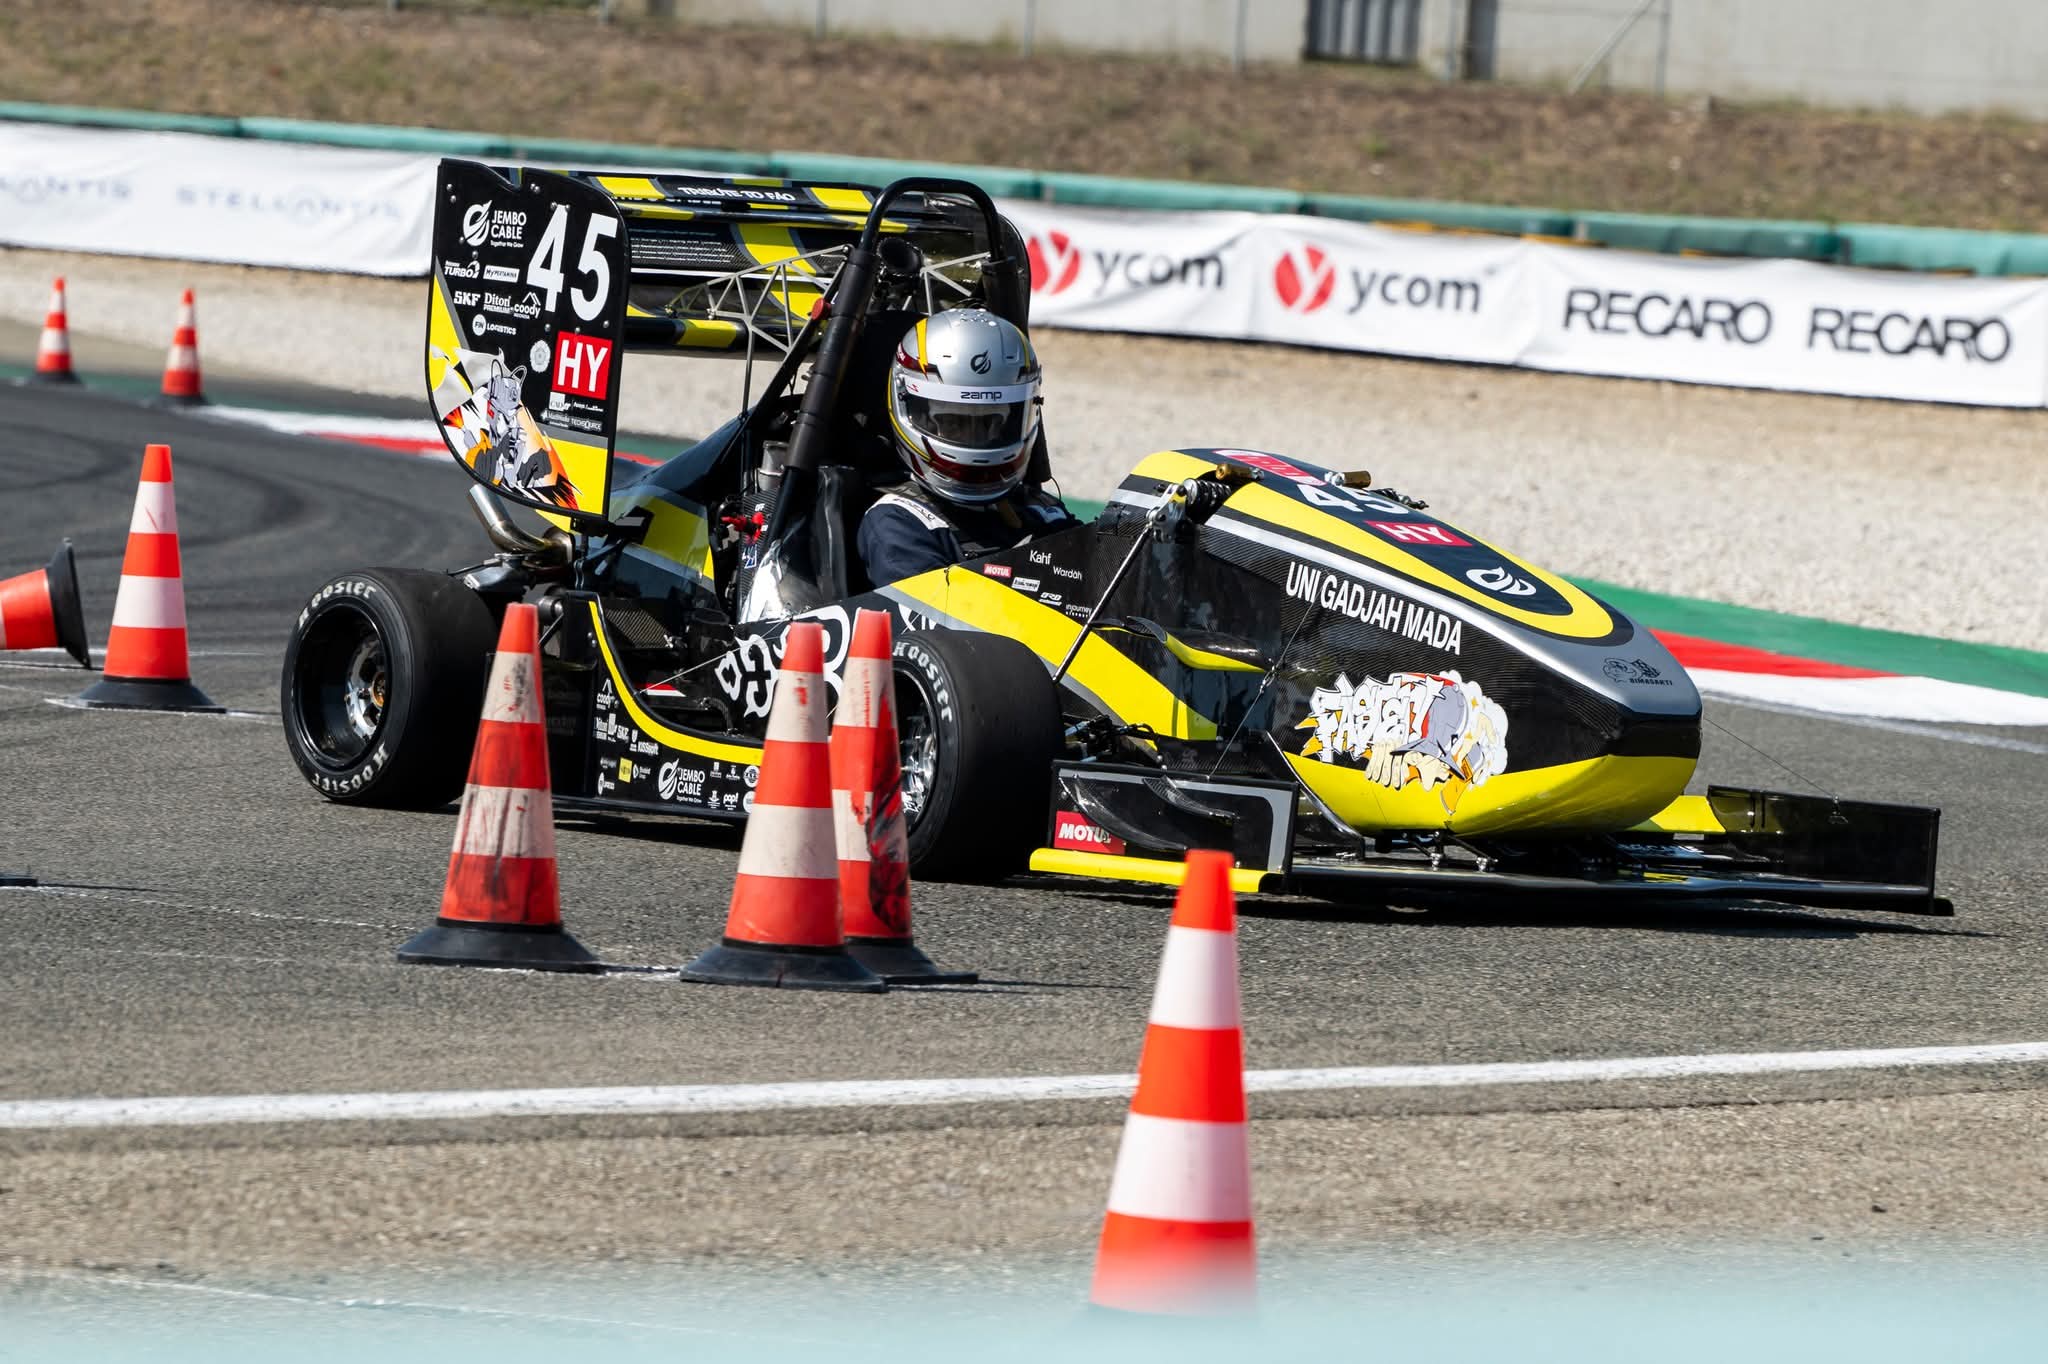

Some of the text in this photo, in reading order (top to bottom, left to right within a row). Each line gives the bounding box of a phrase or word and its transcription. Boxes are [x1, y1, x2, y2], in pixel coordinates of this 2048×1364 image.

[740, 190, 764, 199] TO
[491, 210, 527, 226] JEMBO
[490, 224, 523, 240] CABLE
[526, 204, 618, 321] 45
[1094, 248, 1224, 293] ycom
[444, 266, 474, 279] TURBO
[1347, 265, 1481, 314] ycom
[453, 290, 481, 307] SKF
[514, 302, 541, 319] coody
[1563, 287, 2011, 363] RECARO RECARO
[557, 339, 608, 393] HY
[960, 391, 1002, 401] zamp
[1296, 484, 1410, 514] 45
[1375, 524, 1453, 543] HY
[1029, 549, 1052, 565] Kahf
[984, 566, 1010, 577] MOTUL
[1053, 566, 1083, 581] Wardah
[1285, 561, 1462, 655] UNI GADJAH MADA
[678, 768, 706, 783] JEMBO
[677, 781, 702, 796] CABLE
